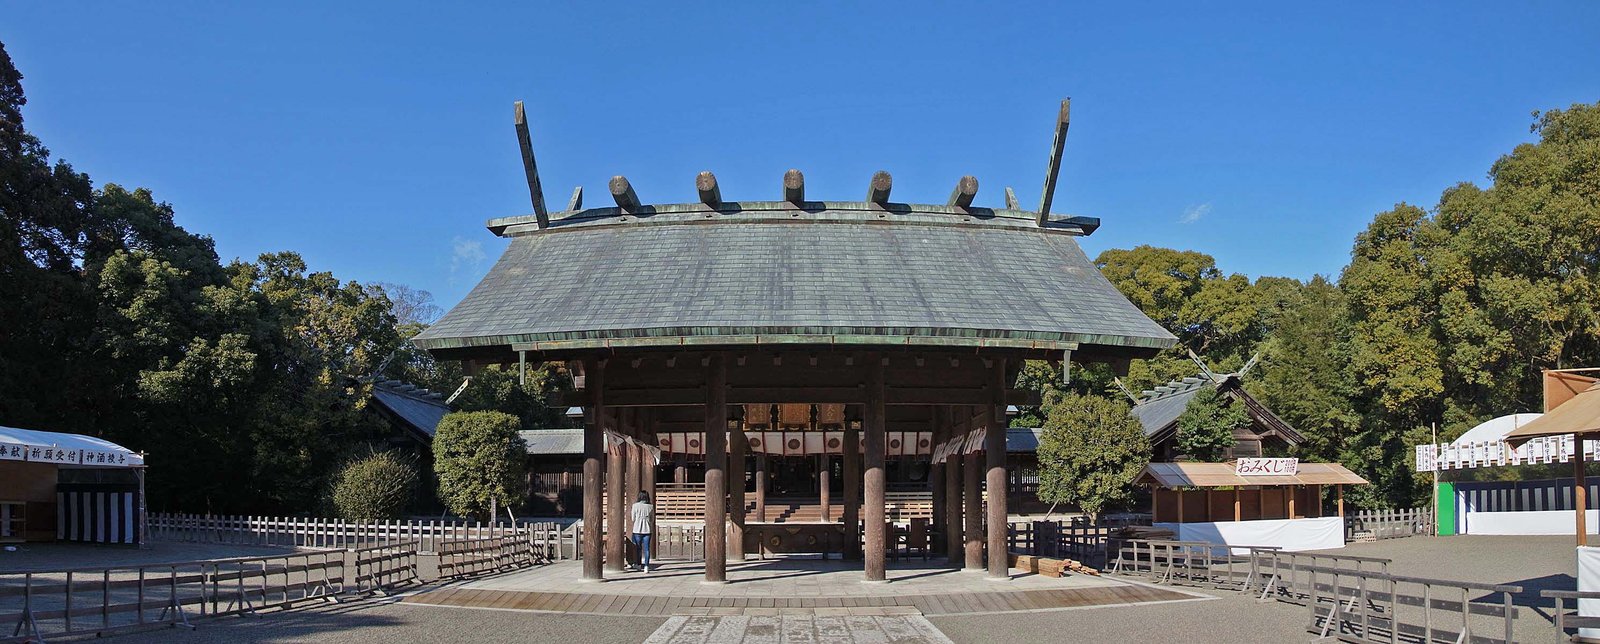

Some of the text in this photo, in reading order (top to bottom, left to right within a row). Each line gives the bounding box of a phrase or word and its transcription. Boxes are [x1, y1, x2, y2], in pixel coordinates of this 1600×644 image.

[32, 447, 76, 462] 祈願受付
[86, 451, 126, 464] 神酒授与
[1238, 459, 1285, 473] おみくじ
